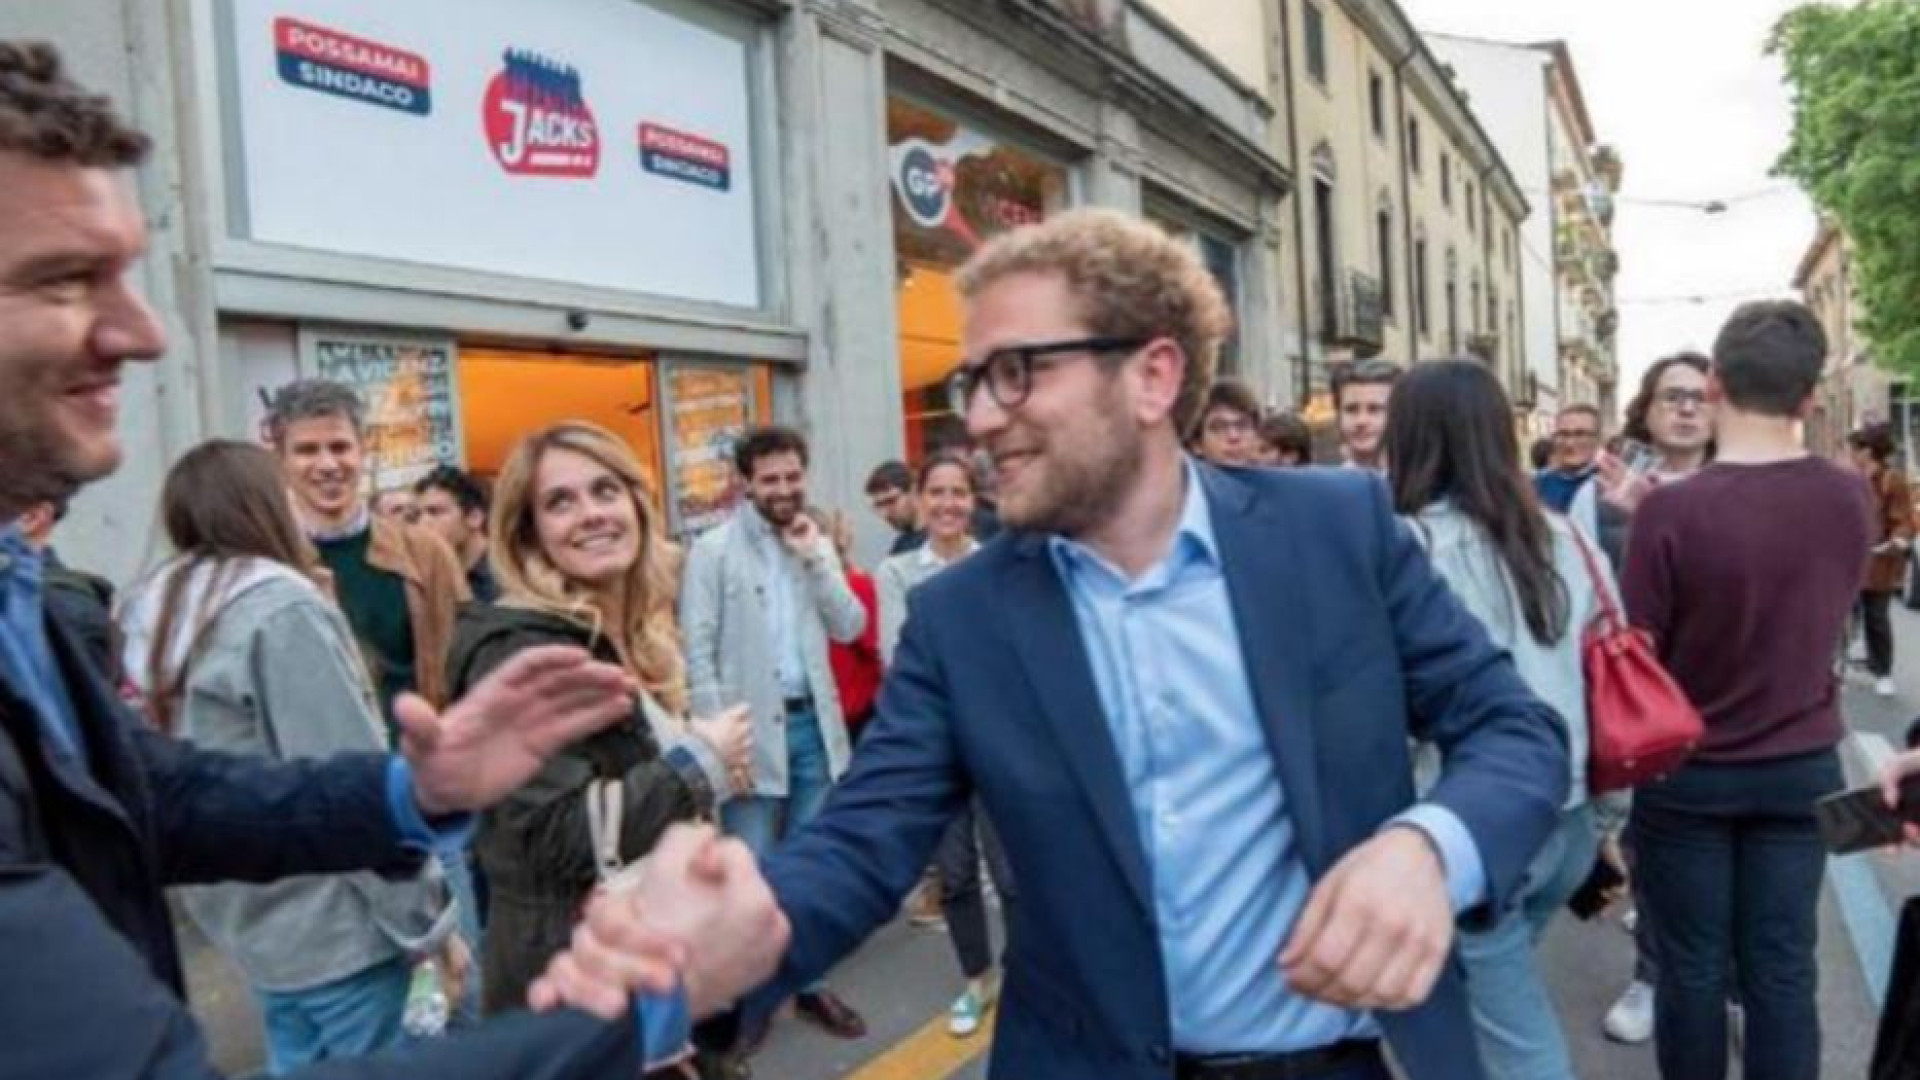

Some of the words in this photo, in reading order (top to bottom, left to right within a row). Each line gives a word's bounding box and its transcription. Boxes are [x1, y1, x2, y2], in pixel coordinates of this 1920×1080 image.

[288, 26, 419, 78] POSSAMAI
[299, 61, 413, 106] SINDACO
[501, 99, 592, 165] JACKS
